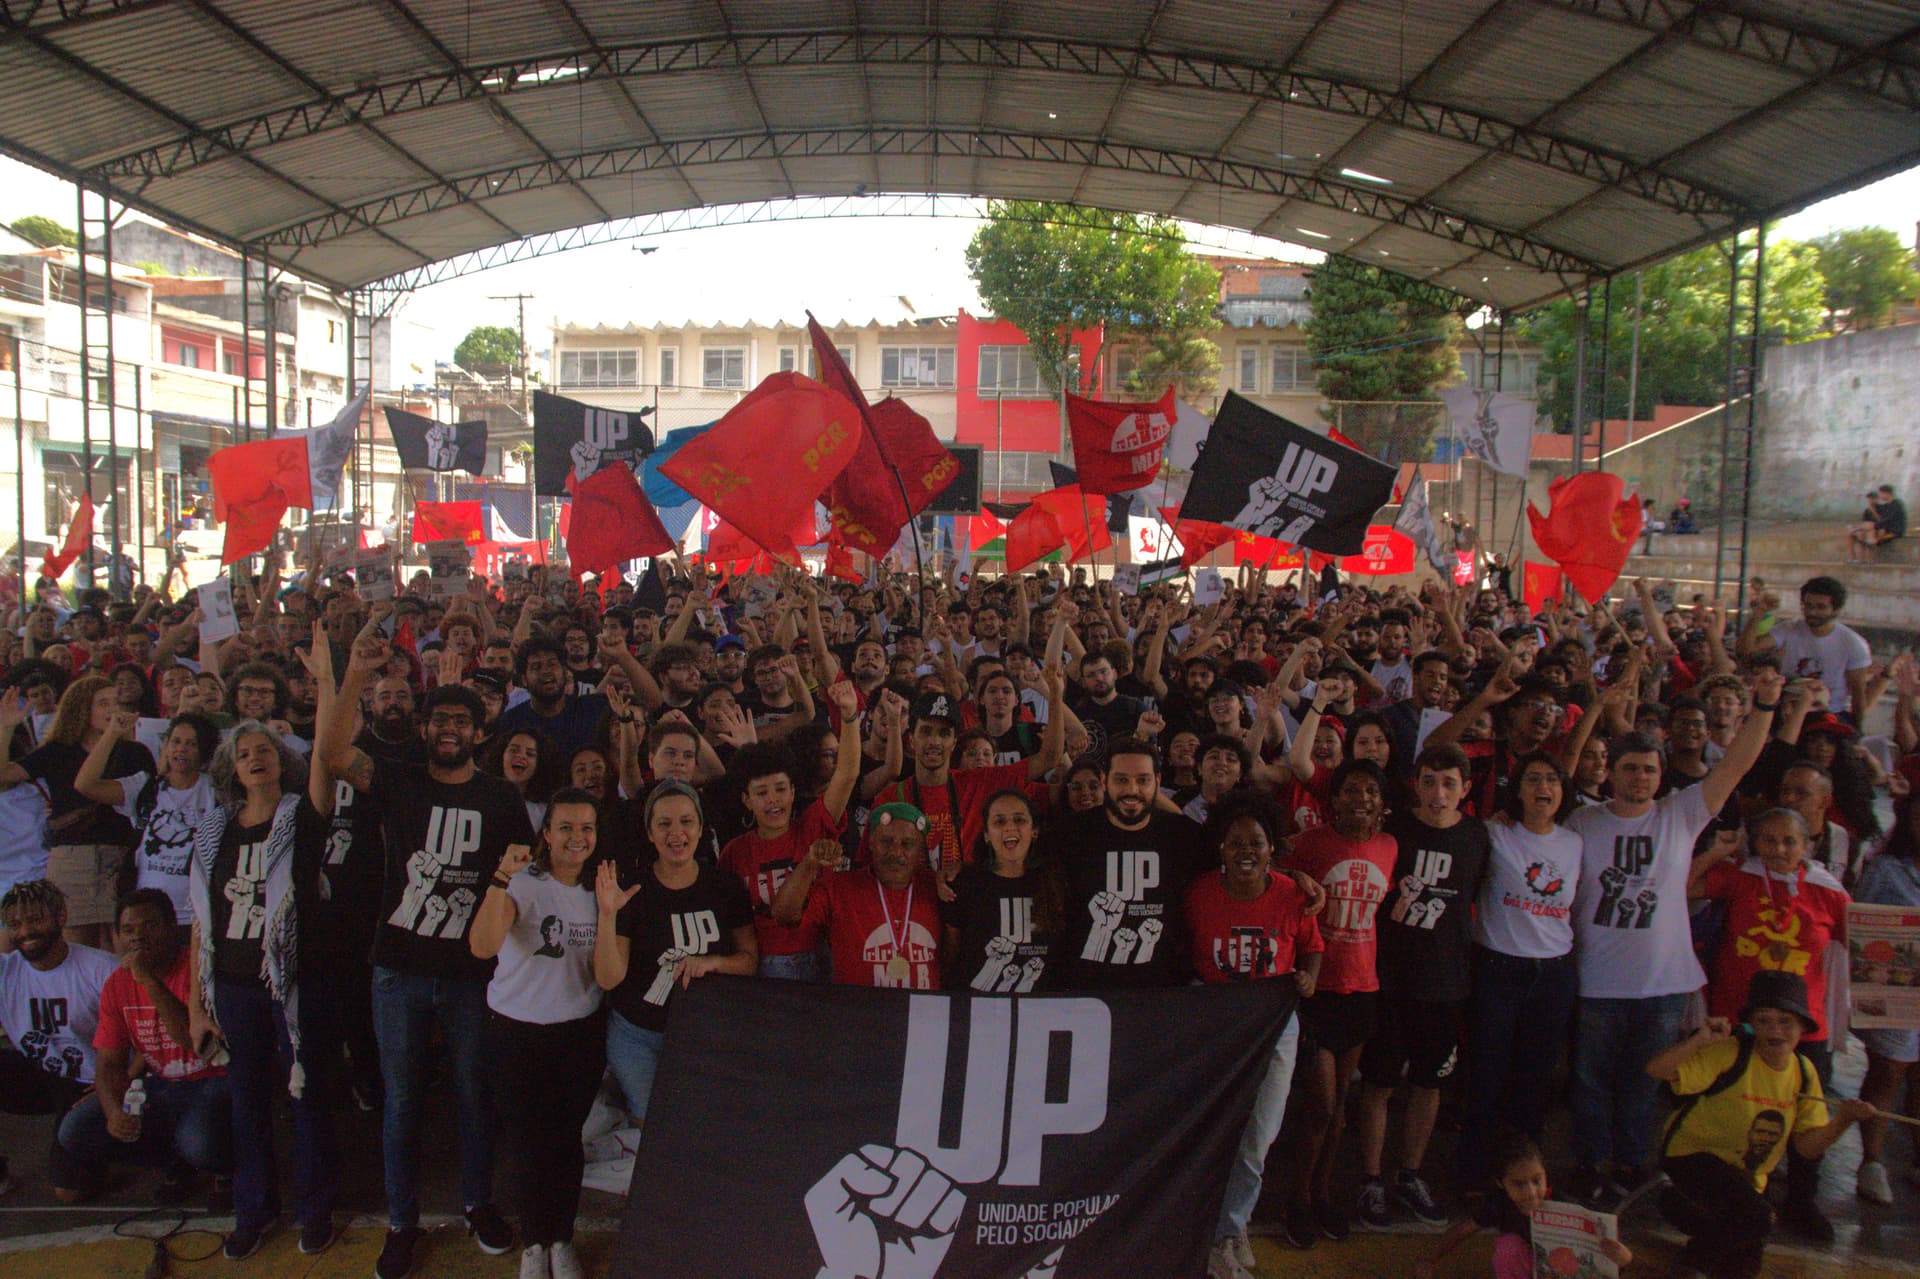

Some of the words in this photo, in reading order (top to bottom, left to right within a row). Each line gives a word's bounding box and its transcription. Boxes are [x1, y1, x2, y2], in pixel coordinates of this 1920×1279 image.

[583, 409, 629, 450] UP
[1275, 441, 1338, 498] UP
[425, 806, 482, 866] UP
[1614, 835, 1653, 875] UP
[1106, 851, 1160, 901] UP
[1413, 849, 1453, 886] UP
[671, 910, 721, 955] UP
[1736, 936, 1811, 976] PCR
[30, 998, 67, 1034] UP
[896, 993, 1112, 1187] UP
[978, 1202, 1048, 1223] UNIDADE
[976, 1223, 1018, 1245] PELO
